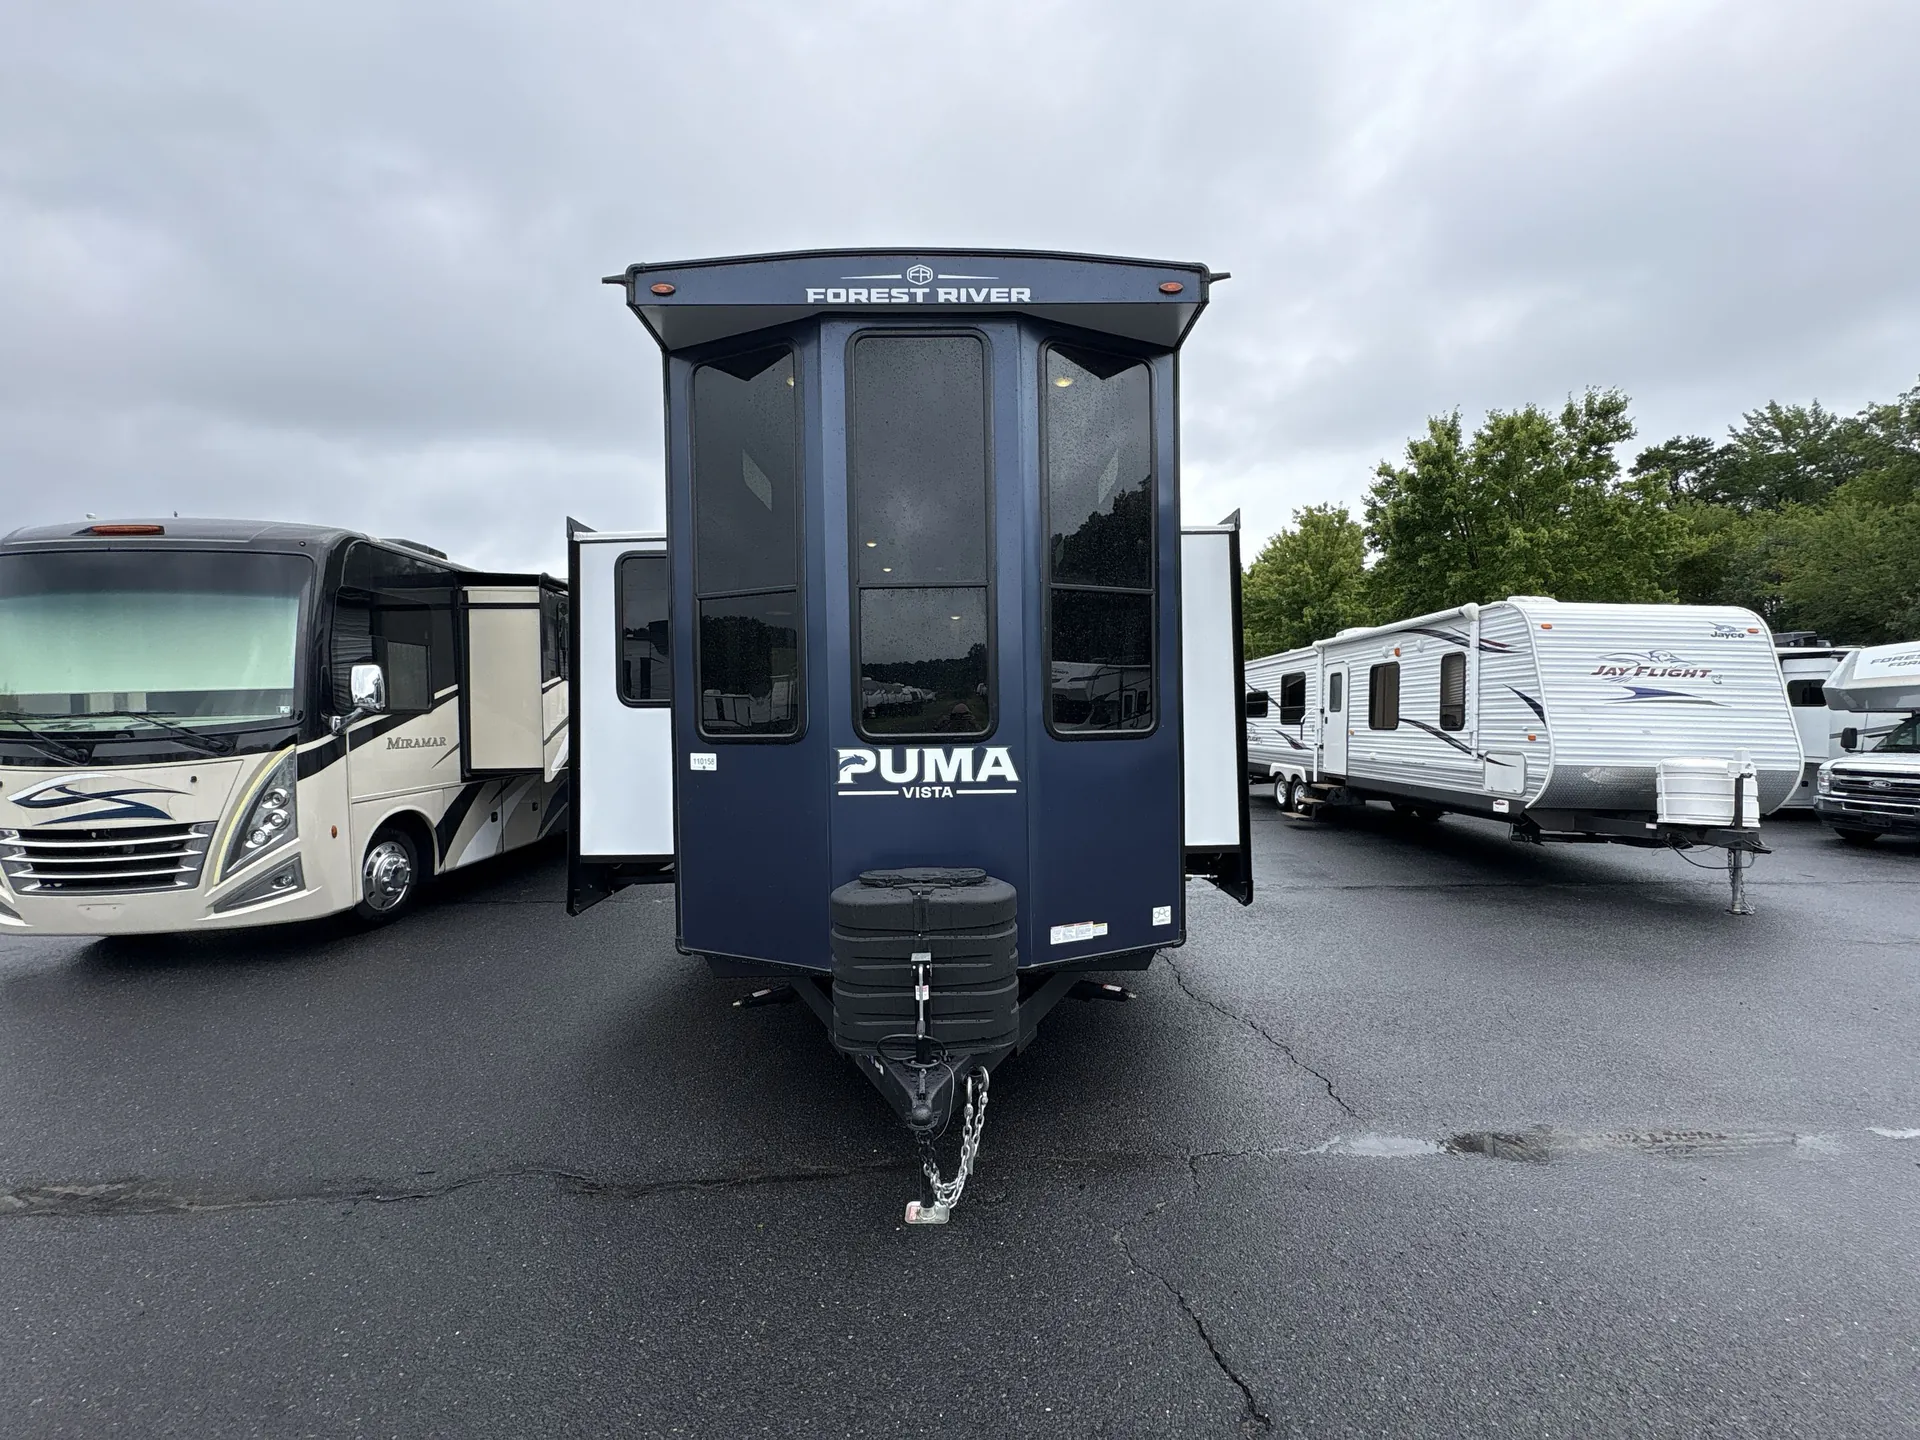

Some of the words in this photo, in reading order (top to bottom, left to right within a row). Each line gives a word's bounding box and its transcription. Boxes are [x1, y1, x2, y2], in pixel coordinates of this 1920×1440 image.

[806, 288, 930, 303] FOREST
[936, 287, 1031, 303] RIVER
[1710, 631, 1745, 639] Jayco
[1591, 665, 1631, 676] JAY
[1634, 666, 1712, 678] FLIGHT
[834, 746, 1021, 784] PUMA
[902, 786, 953, 798] VISTA
